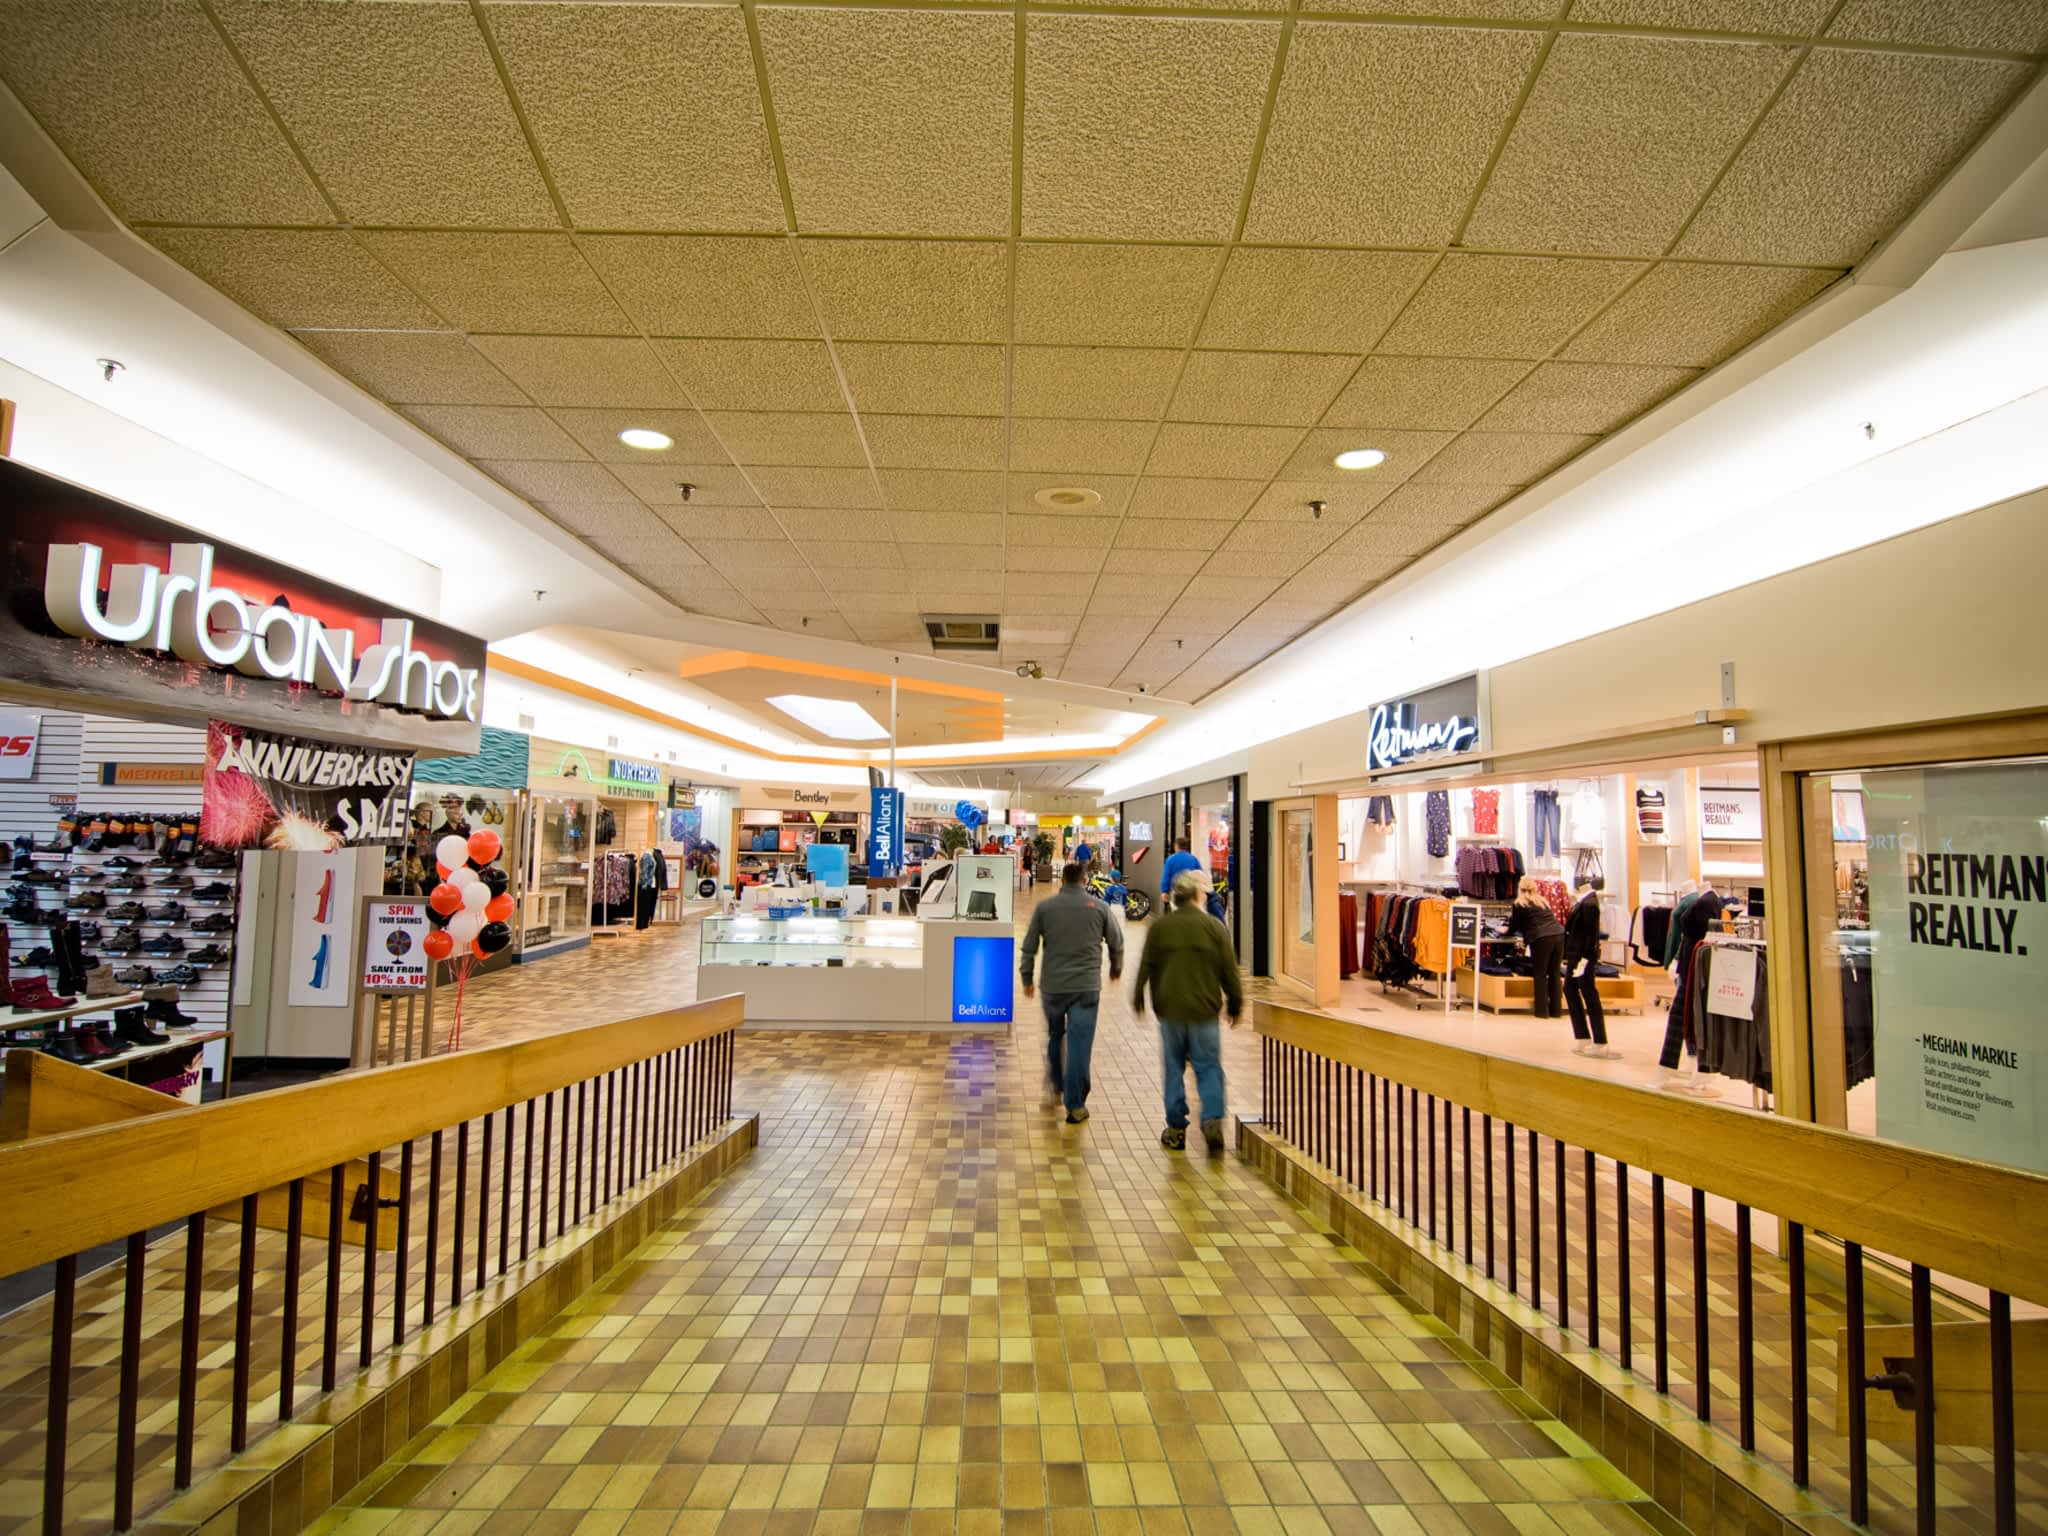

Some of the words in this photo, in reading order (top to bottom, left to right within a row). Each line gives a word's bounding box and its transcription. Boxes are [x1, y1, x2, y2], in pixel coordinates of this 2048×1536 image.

[1366, 703, 1475, 770] Reitmans
[216, 735, 413, 787] ANNIVERSARY
[609, 759, 662, 785] NORTHERN
[607, 784, 655, 799] REFLECTIONS
[794, 790, 830, 805] Bentley
[337, 798, 408, 841] SALE
[1906, 852, 2048, 903] REITMAN
[388, 905, 414, 915] SPIN
[1909, 901, 2028, 956] REALLY.
[366, 974, 393, 984] 10%
[396, 976, 406, 984] &
[371, 965, 395, 973] SAVE
[1971, 1043, 2019, 1070] MARKLE
